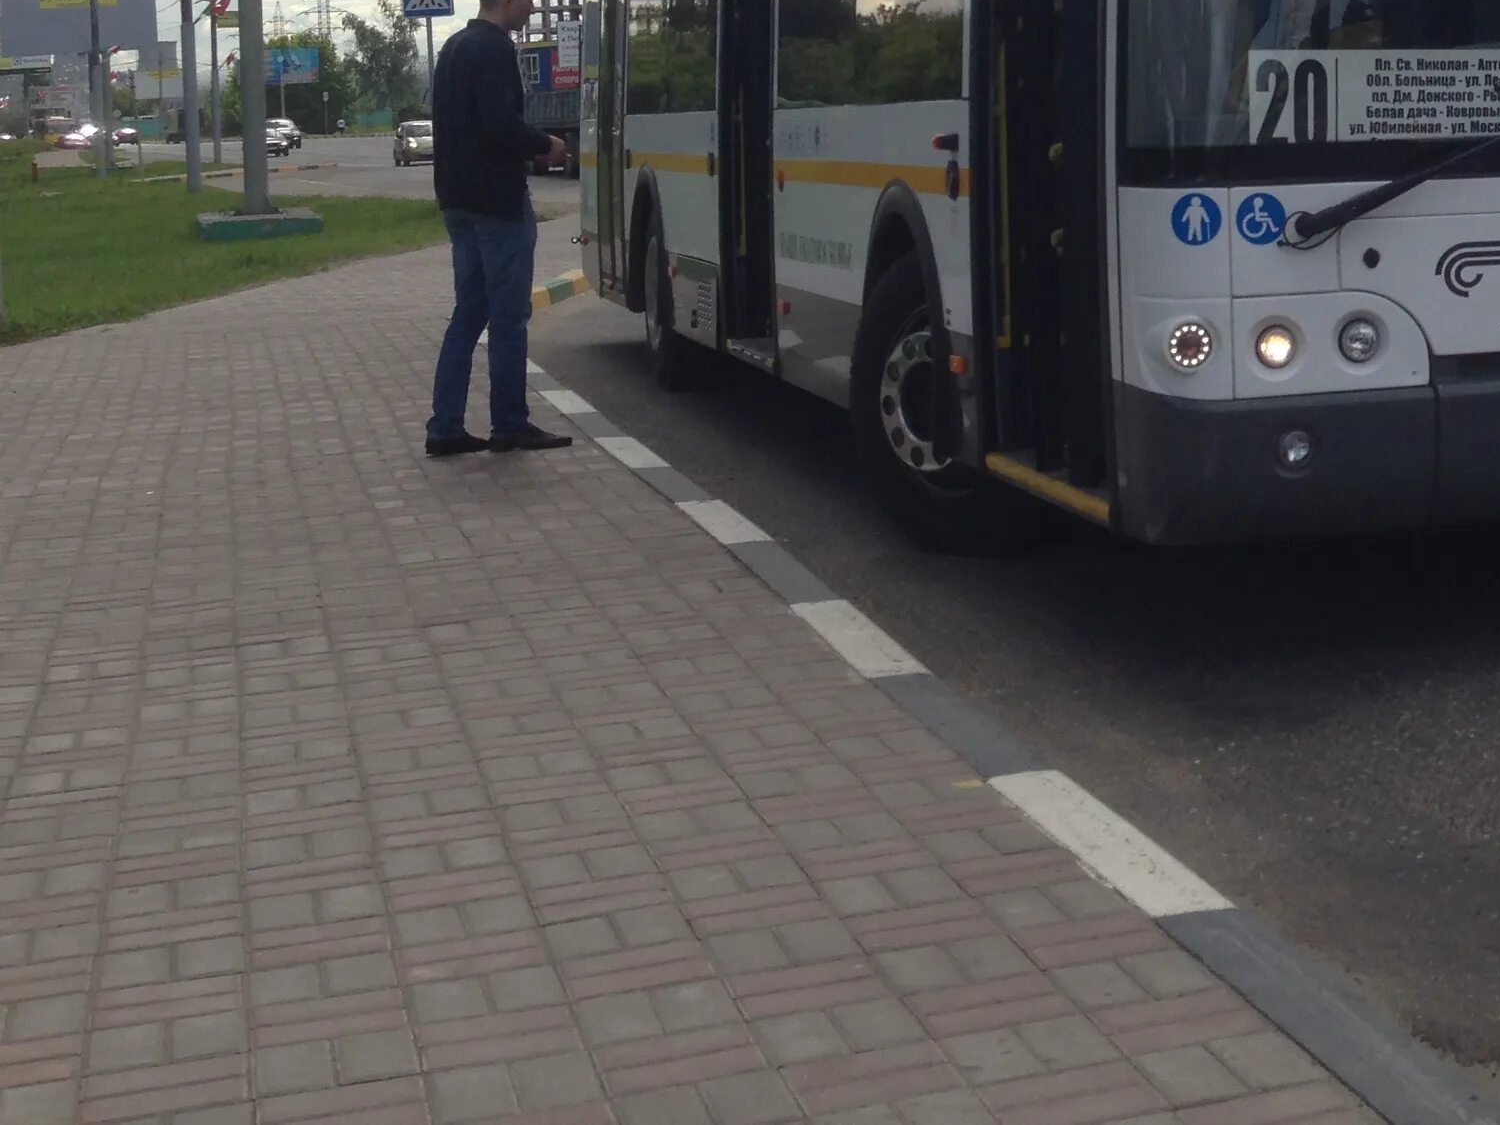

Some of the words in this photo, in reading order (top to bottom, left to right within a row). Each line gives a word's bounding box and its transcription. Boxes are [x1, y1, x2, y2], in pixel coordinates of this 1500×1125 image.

[1375, 59, 1394, 72] Пл.
[1396, 59, 1414, 71] Св.
[1416, 59, 1469, 71] Николая
[1366, 74, 1393, 87] Обл.
[1395, 74, 1456, 88] Больница
[1465, 76, 1481, 87] ул.
[1256, 59, 1328, 145] 20
[1372, 92, 1390, 104] пл.
[1393, 91, 1414, 105] Дм.
[1417, 91, 1474, 104] Донского
[1366, 106, 1404, 118] Белая
[1407, 108, 1437, 119] дача
[1349, 123, 1366, 135] ул.
[1369, 121, 1442, 135] Юбилейная
[1451, 122, 1467, 134] ул.
